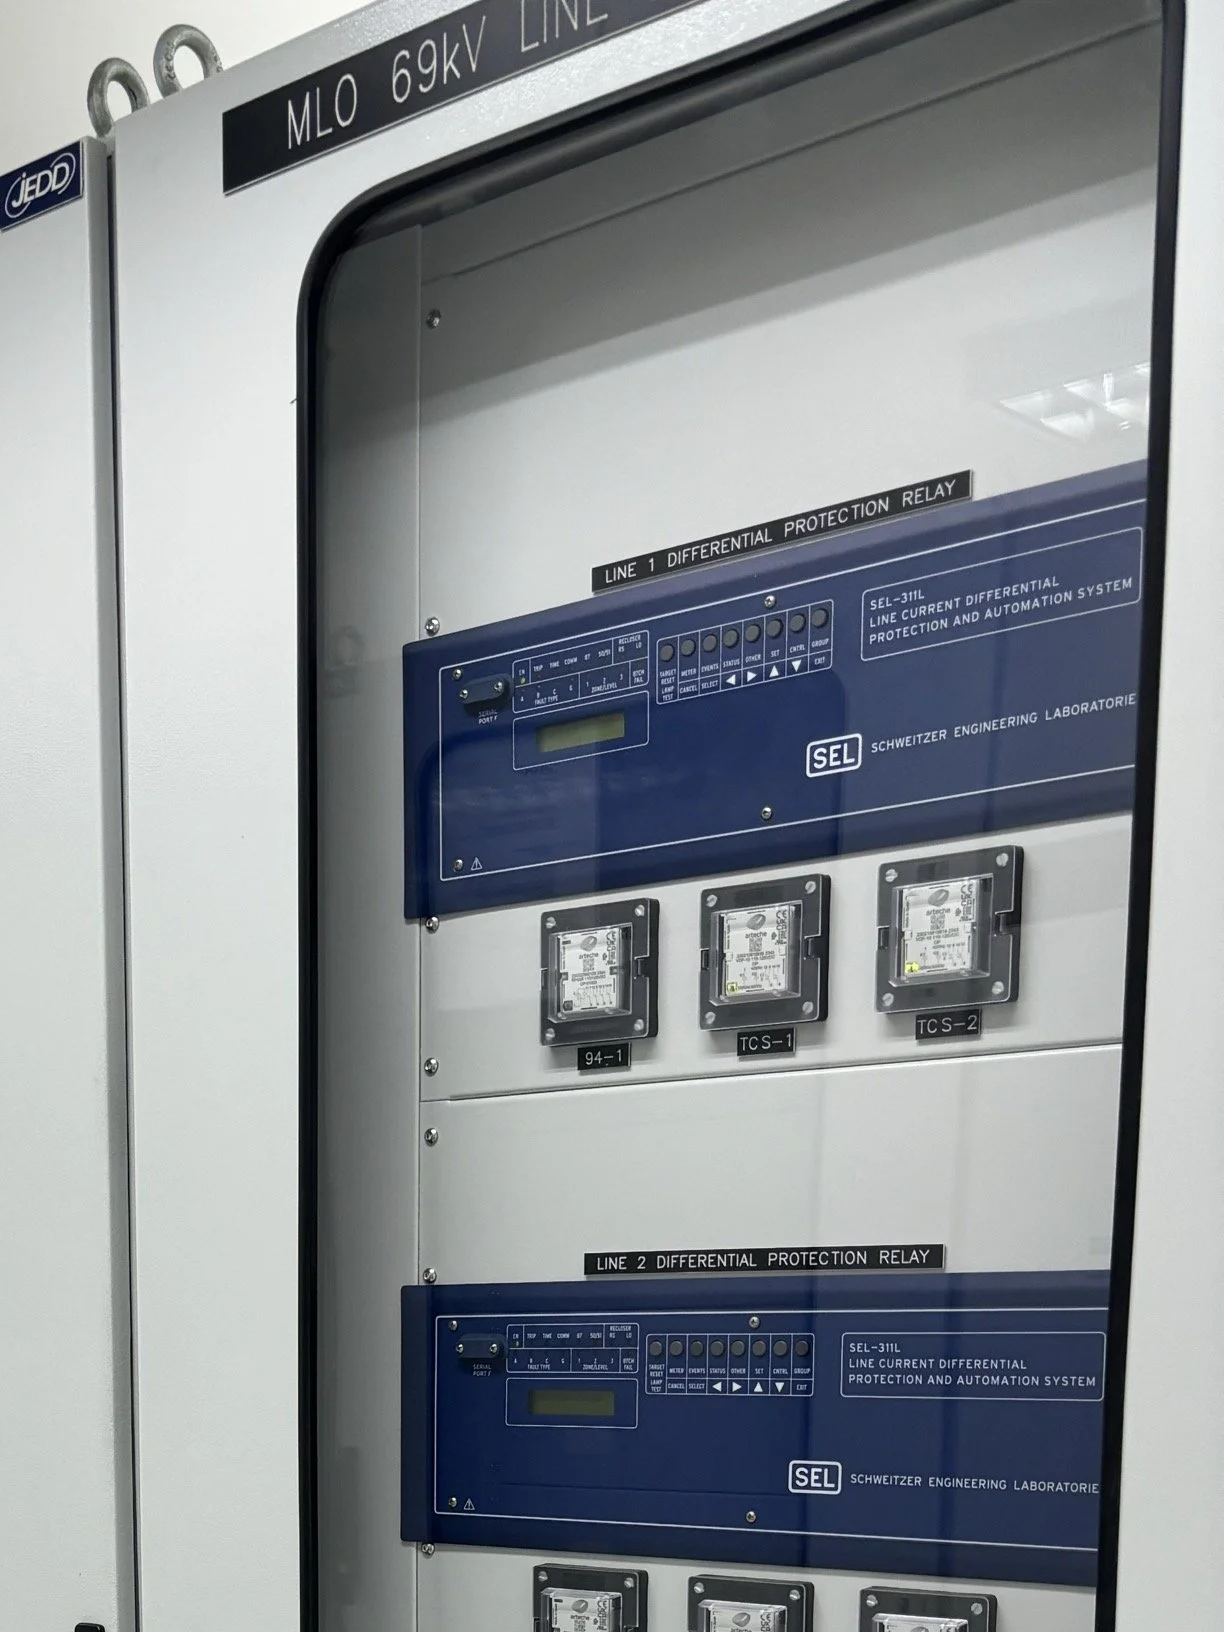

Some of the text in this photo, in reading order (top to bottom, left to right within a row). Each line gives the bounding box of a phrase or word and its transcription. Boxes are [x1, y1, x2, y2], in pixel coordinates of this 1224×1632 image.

[287, 73, 358, 149] MLO
[392, 15, 486, 103] 69kV
[605, 480, 956, 584] LINE 1 DIFFERENTIAL PROTECTION RELAY
[870, 590, 925, 611] SEL-311L
[870, 577, 1060, 628] LINE CURRENT DIFFERENTIAL
[869, 577, 1133, 645] PROTECTION AND AUTOMATION SYSTEM
[812, 638, 829, 648] GROUP
[745, 653, 761, 663] OTHER
[770, 649, 780, 657] SET
[701, 663, 719, 673] EVENTS
[723, 658, 740, 668] STATUS
[681, 667, 697, 677] METER
[680, 684, 698, 693] CANCEL
[701, 680, 718, 689] SELECT
[812, 743, 856, 770] SEL
[871, 729, 947, 753] SCHWEITZER
[954, 712, 1037, 739] ENGINEERING
[917, 1015, 978, 1034] TCS-2
[740, 1034, 793, 1052] TCS-1
[585, 1047, 622, 1066] 94-1
[597, 1249, 930, 1271] LINE 2 DIFFERENTIAL PROTECTION RELAY
[849, 1342, 901, 1353] SEL-311L
[849, 1358, 1027, 1370] LINE CURRENT DIFFERENTIAL
[848, 1374, 1096, 1387] PROTECTION AND AUTOMATION SYSTEM
[795, 1467, 836, 1488] SEL
[850, 1473, 922, 1487] SCHWEITZER
[928, 1476, 1008, 1491] ENGINEERING
